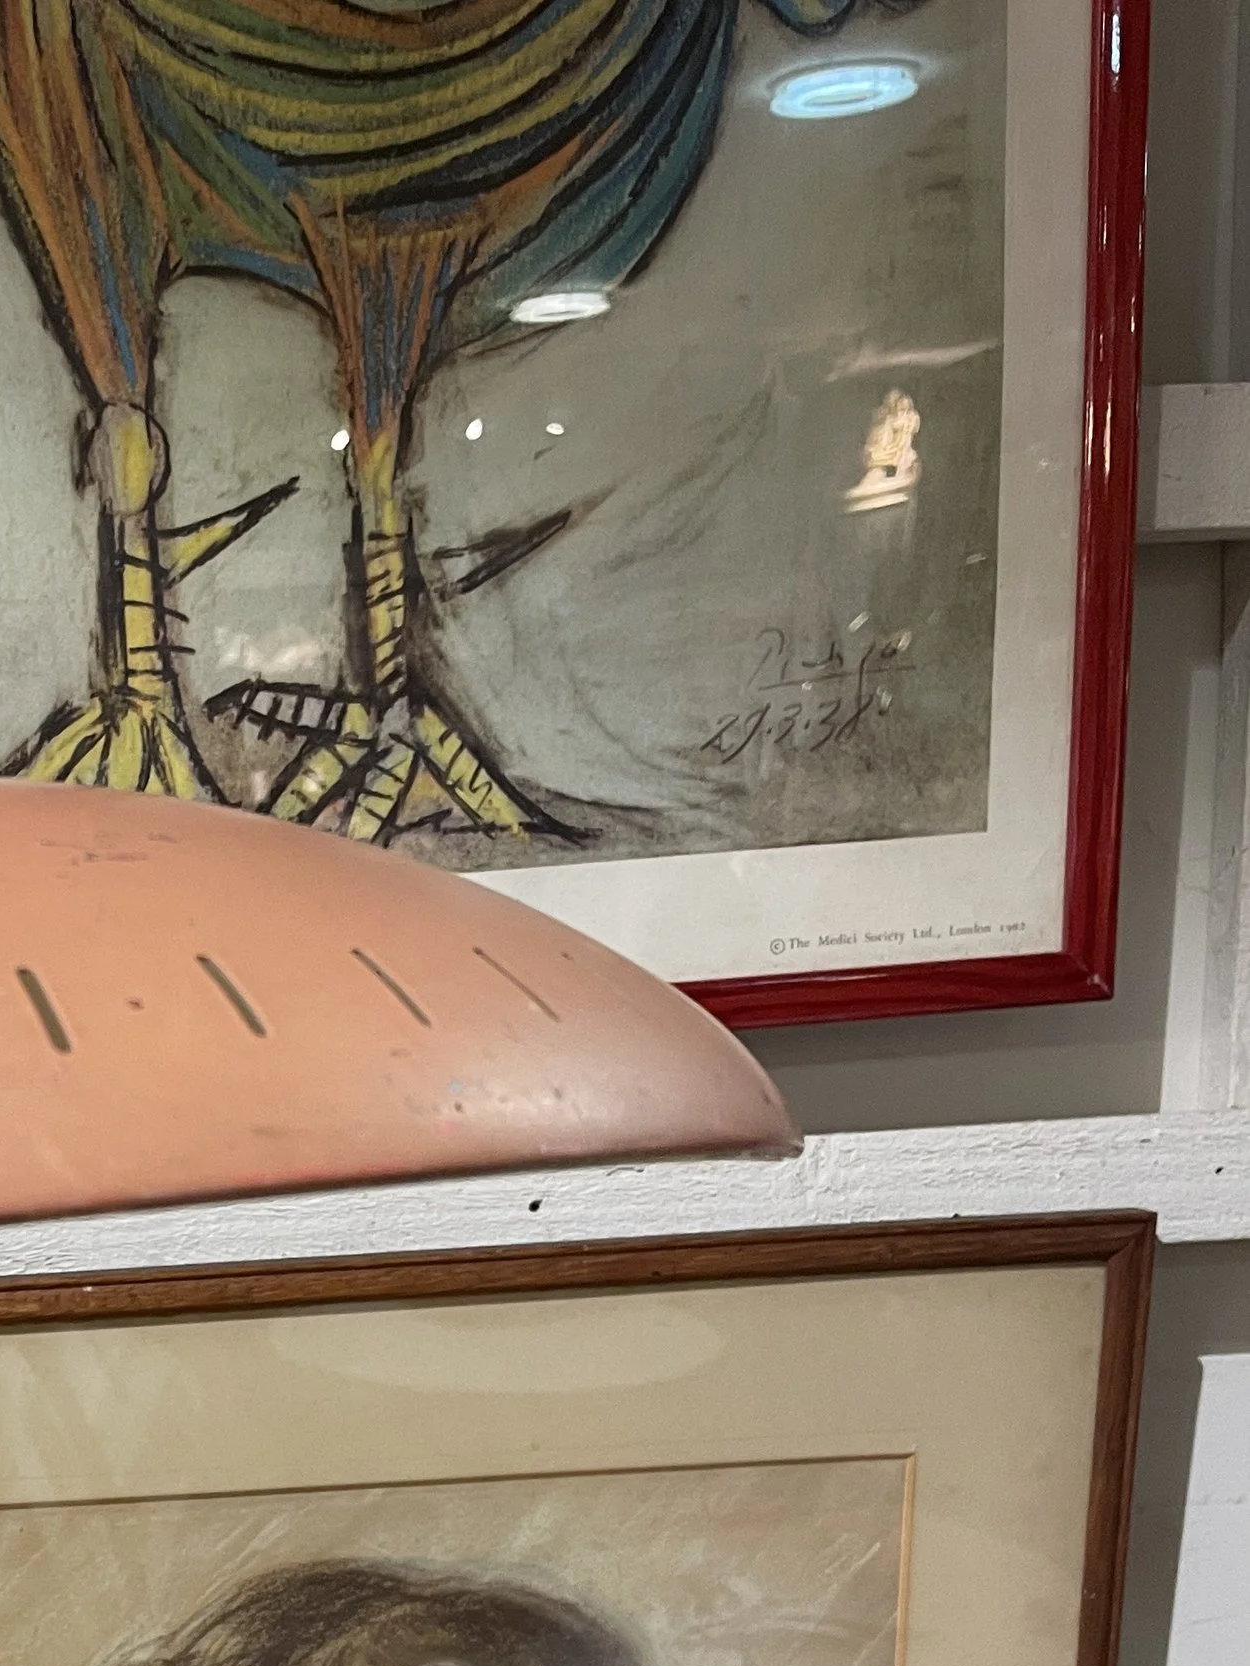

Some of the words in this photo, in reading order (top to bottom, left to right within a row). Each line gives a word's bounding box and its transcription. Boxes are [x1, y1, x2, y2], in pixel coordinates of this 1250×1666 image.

[789, 936, 811, 950] The
[818, 933, 858, 948] Medici
[864, 929, 906, 946] Society
